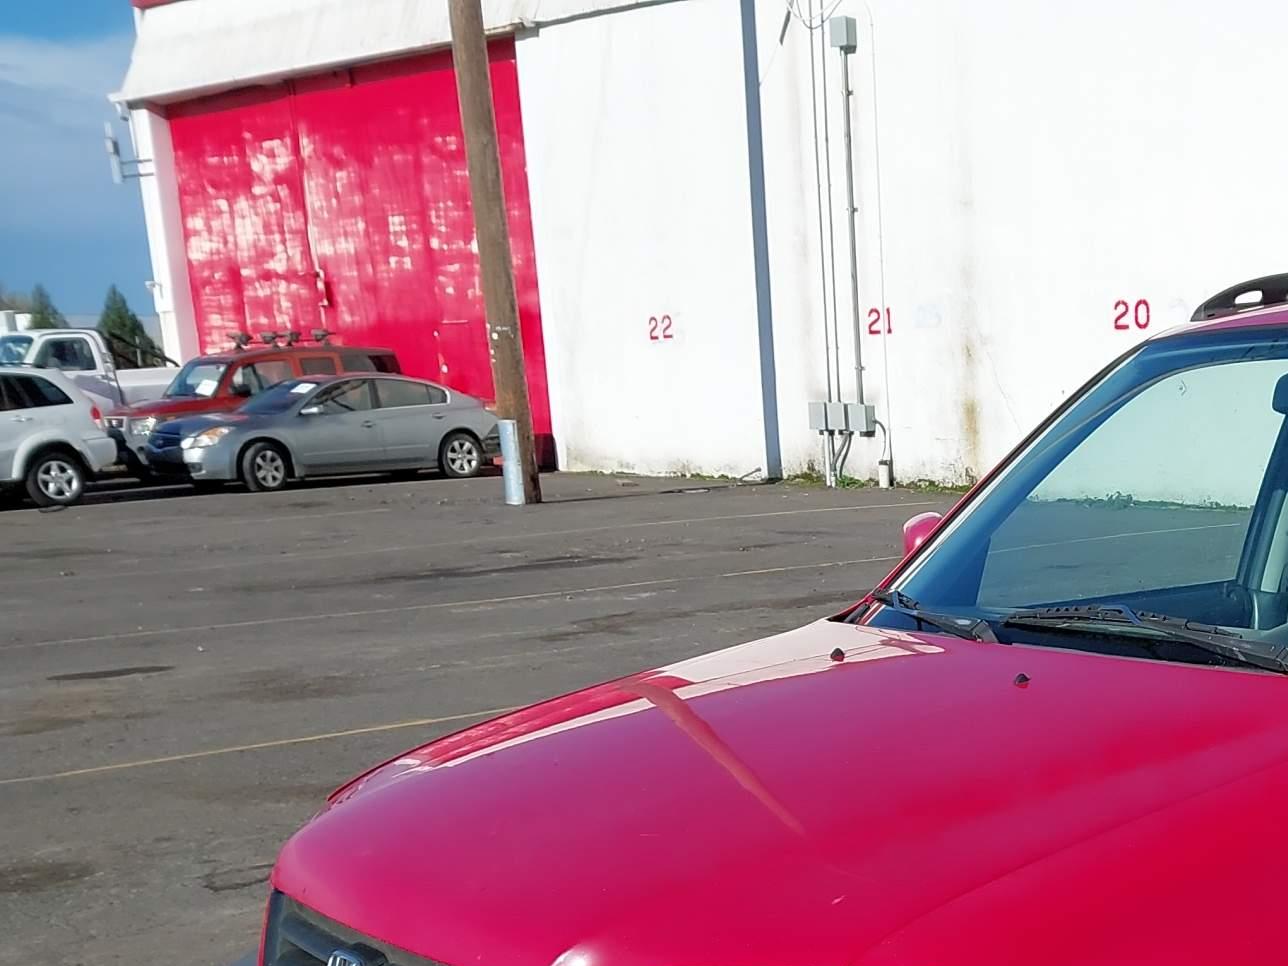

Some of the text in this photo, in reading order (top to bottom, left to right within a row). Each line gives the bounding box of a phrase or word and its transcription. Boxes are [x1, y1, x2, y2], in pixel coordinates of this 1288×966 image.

[648, 314, 674, 341] 22
[867, 307, 893, 335] 21
[1114, 299, 1150, 330] 20
